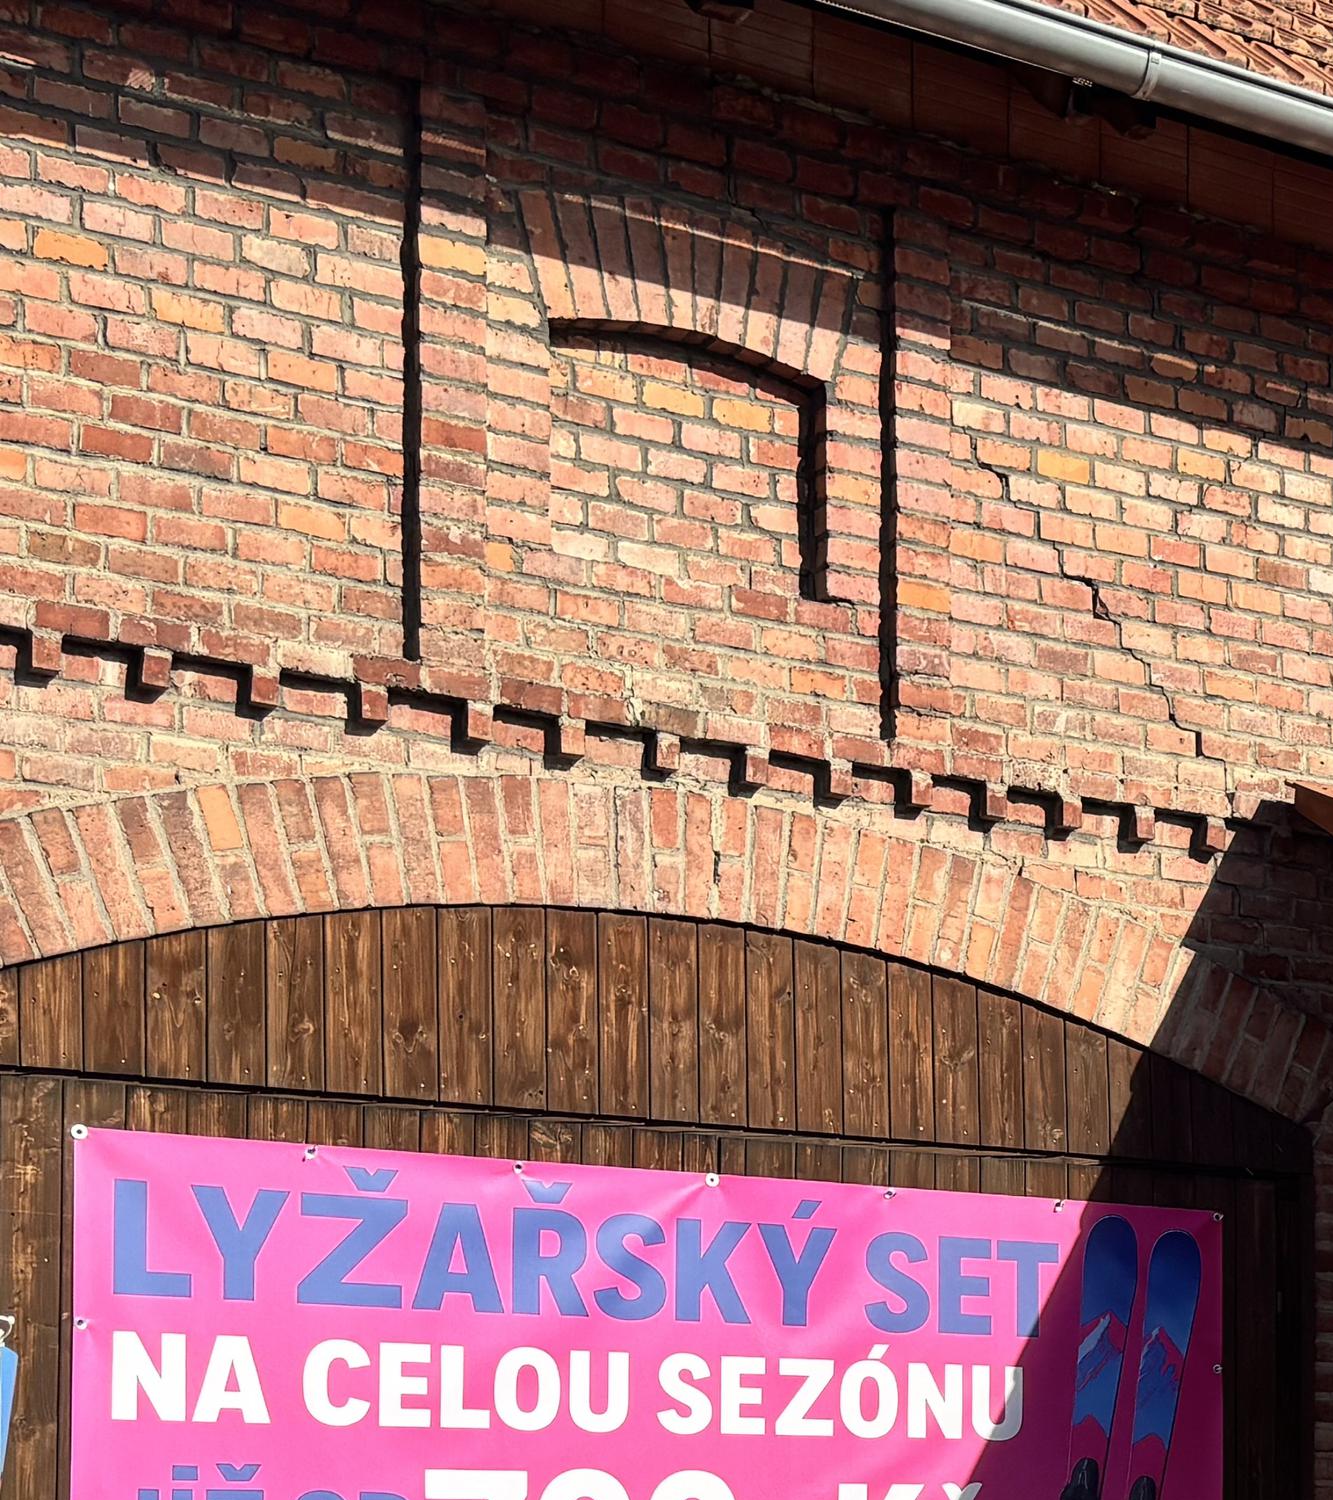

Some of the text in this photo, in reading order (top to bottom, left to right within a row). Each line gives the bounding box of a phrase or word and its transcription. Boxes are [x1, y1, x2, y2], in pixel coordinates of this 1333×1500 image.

[111, 1165, 1060, 1338] LYŽAŘSKÝ SET
[110, 1330, 1024, 1443] NA CELOU SEZÓNU
